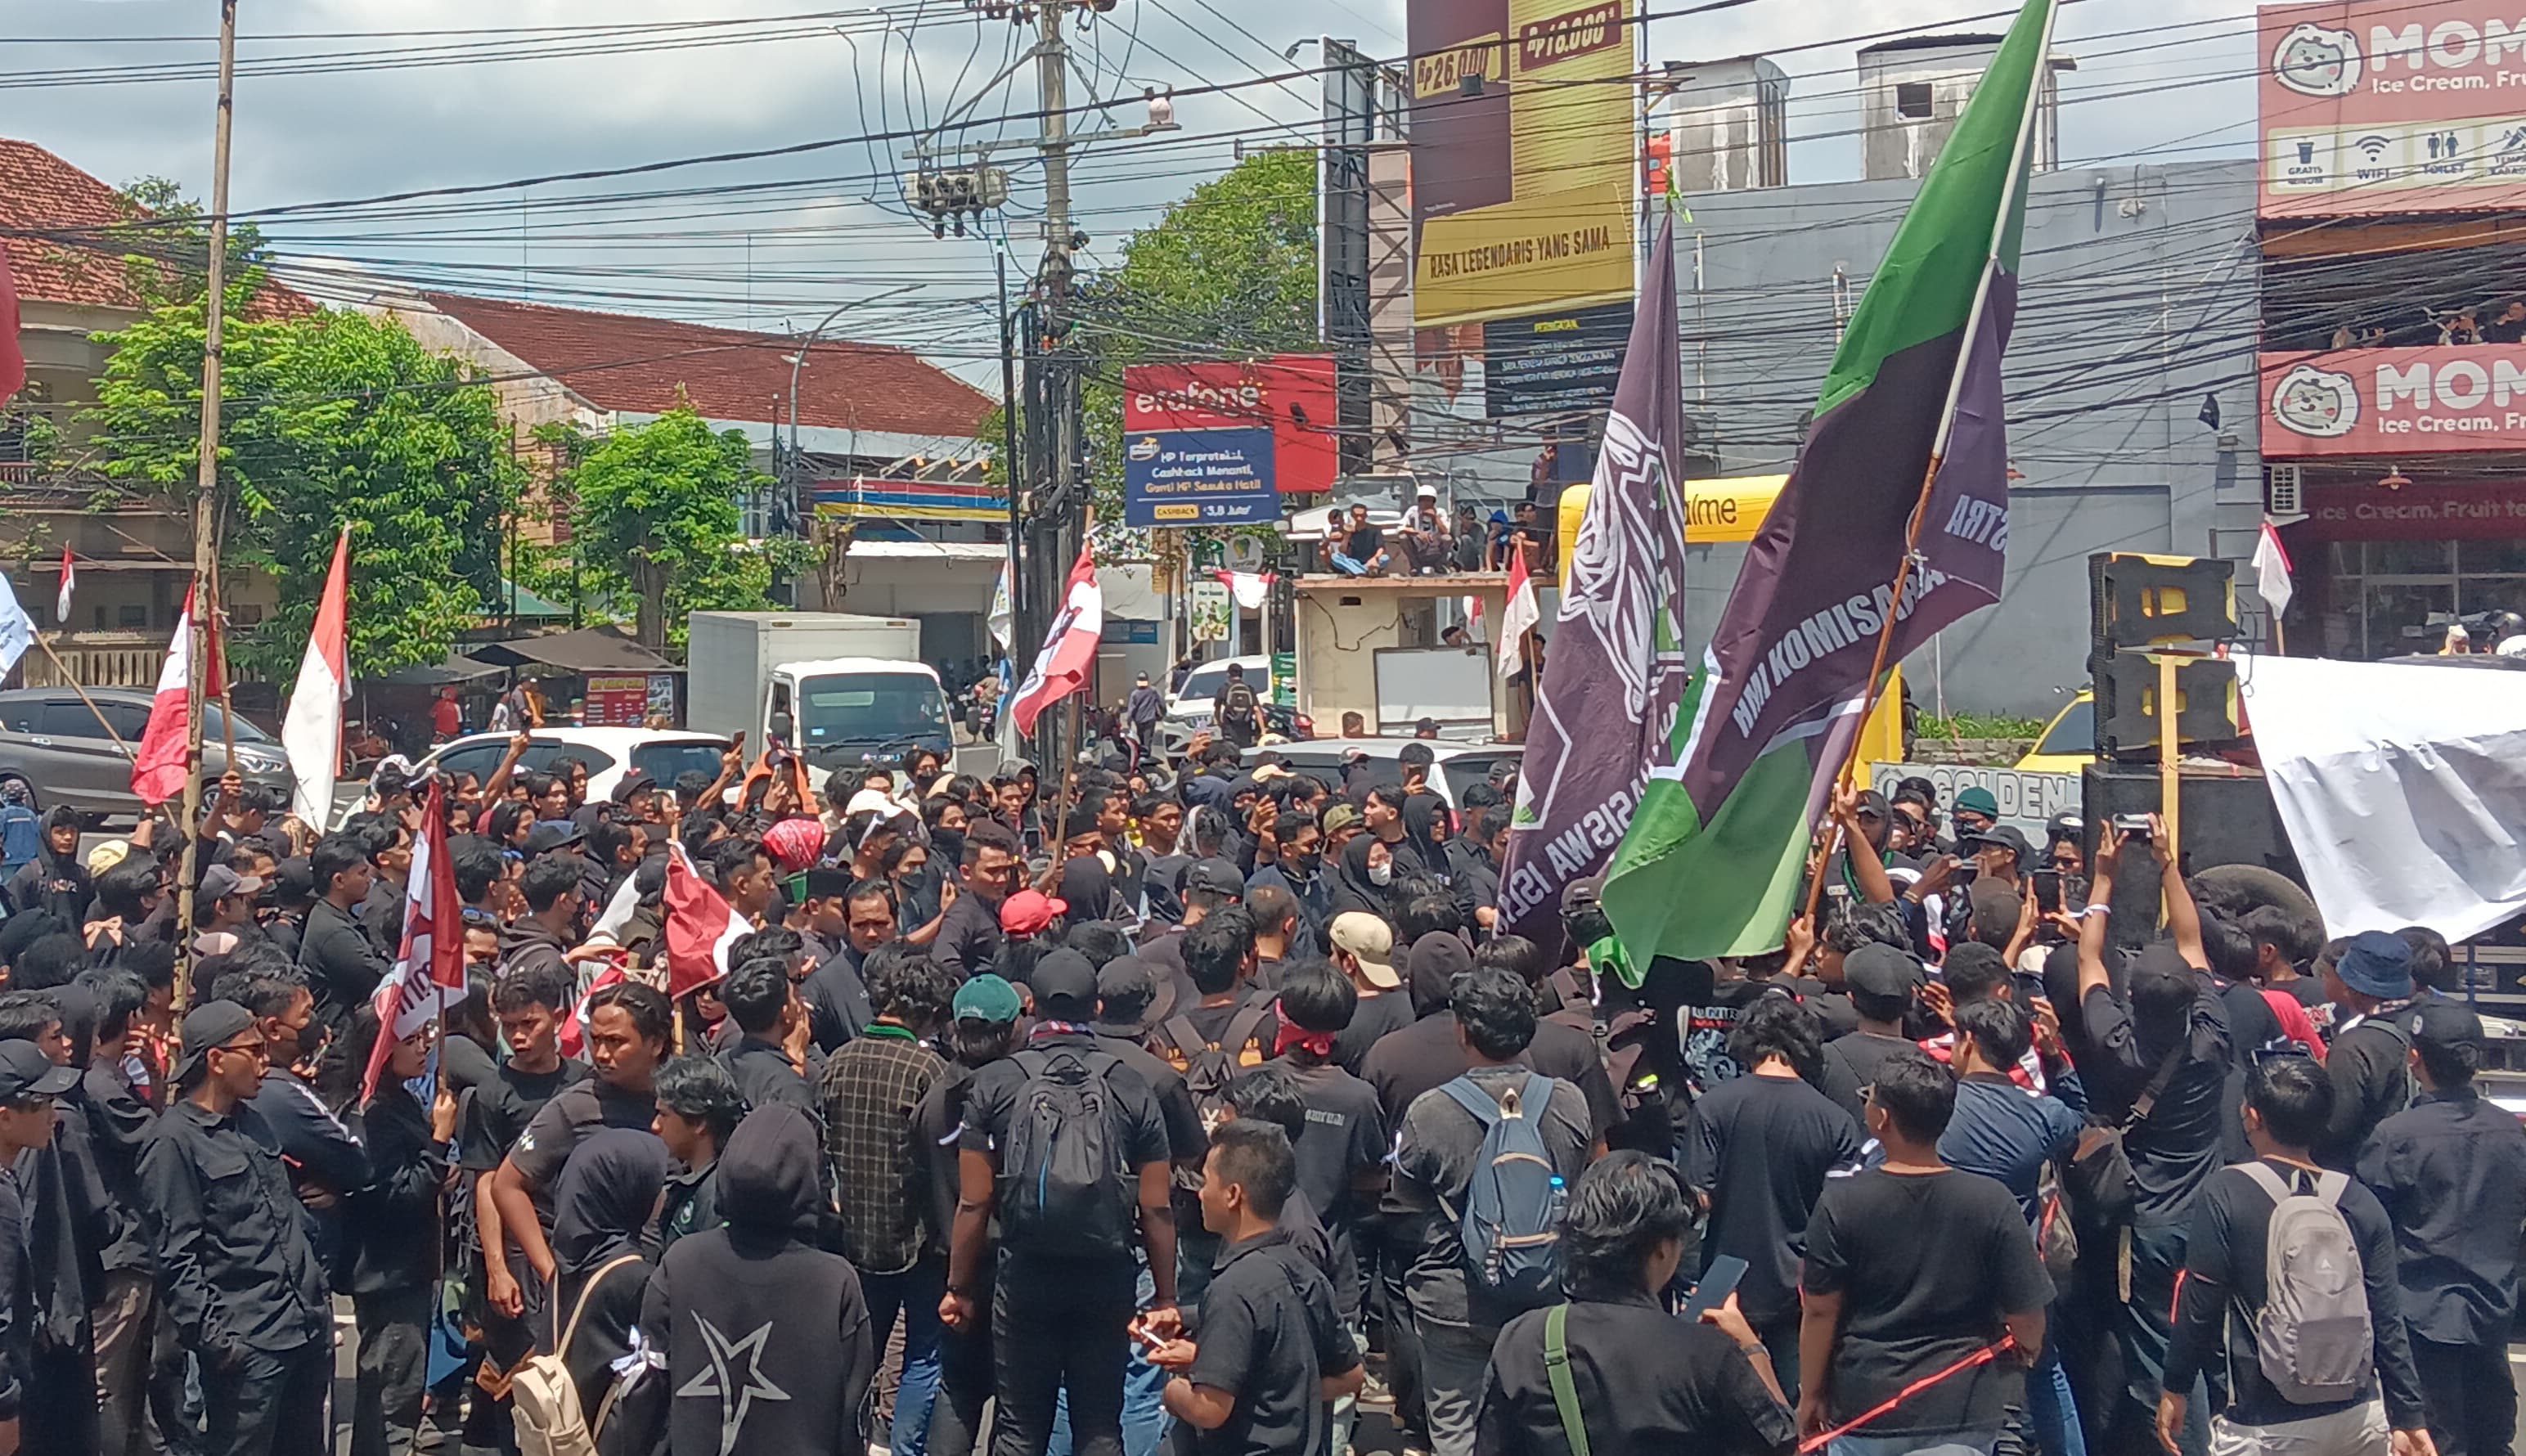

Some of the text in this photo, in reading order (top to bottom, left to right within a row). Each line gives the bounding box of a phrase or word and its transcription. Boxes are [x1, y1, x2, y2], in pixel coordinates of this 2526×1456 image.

[2373, 78, 2405, 94] Ice
[2410, 75, 2490, 92] Cream,
[2288, 166, 2323, 176] GRATIS
[2357, 168, 2390, 179] WIFI
[1431, 226, 1610, 278] RASA LEGENDARIS YANG SAMA
[2378, 416, 2411, 433] Ice
[1152, 466, 1203, 478] Cashback
[1156, 508, 1195, 516] CASHBACK
[2443, 500, 2501, 519] Fruit
[1733, 662, 1772, 739] HMI
